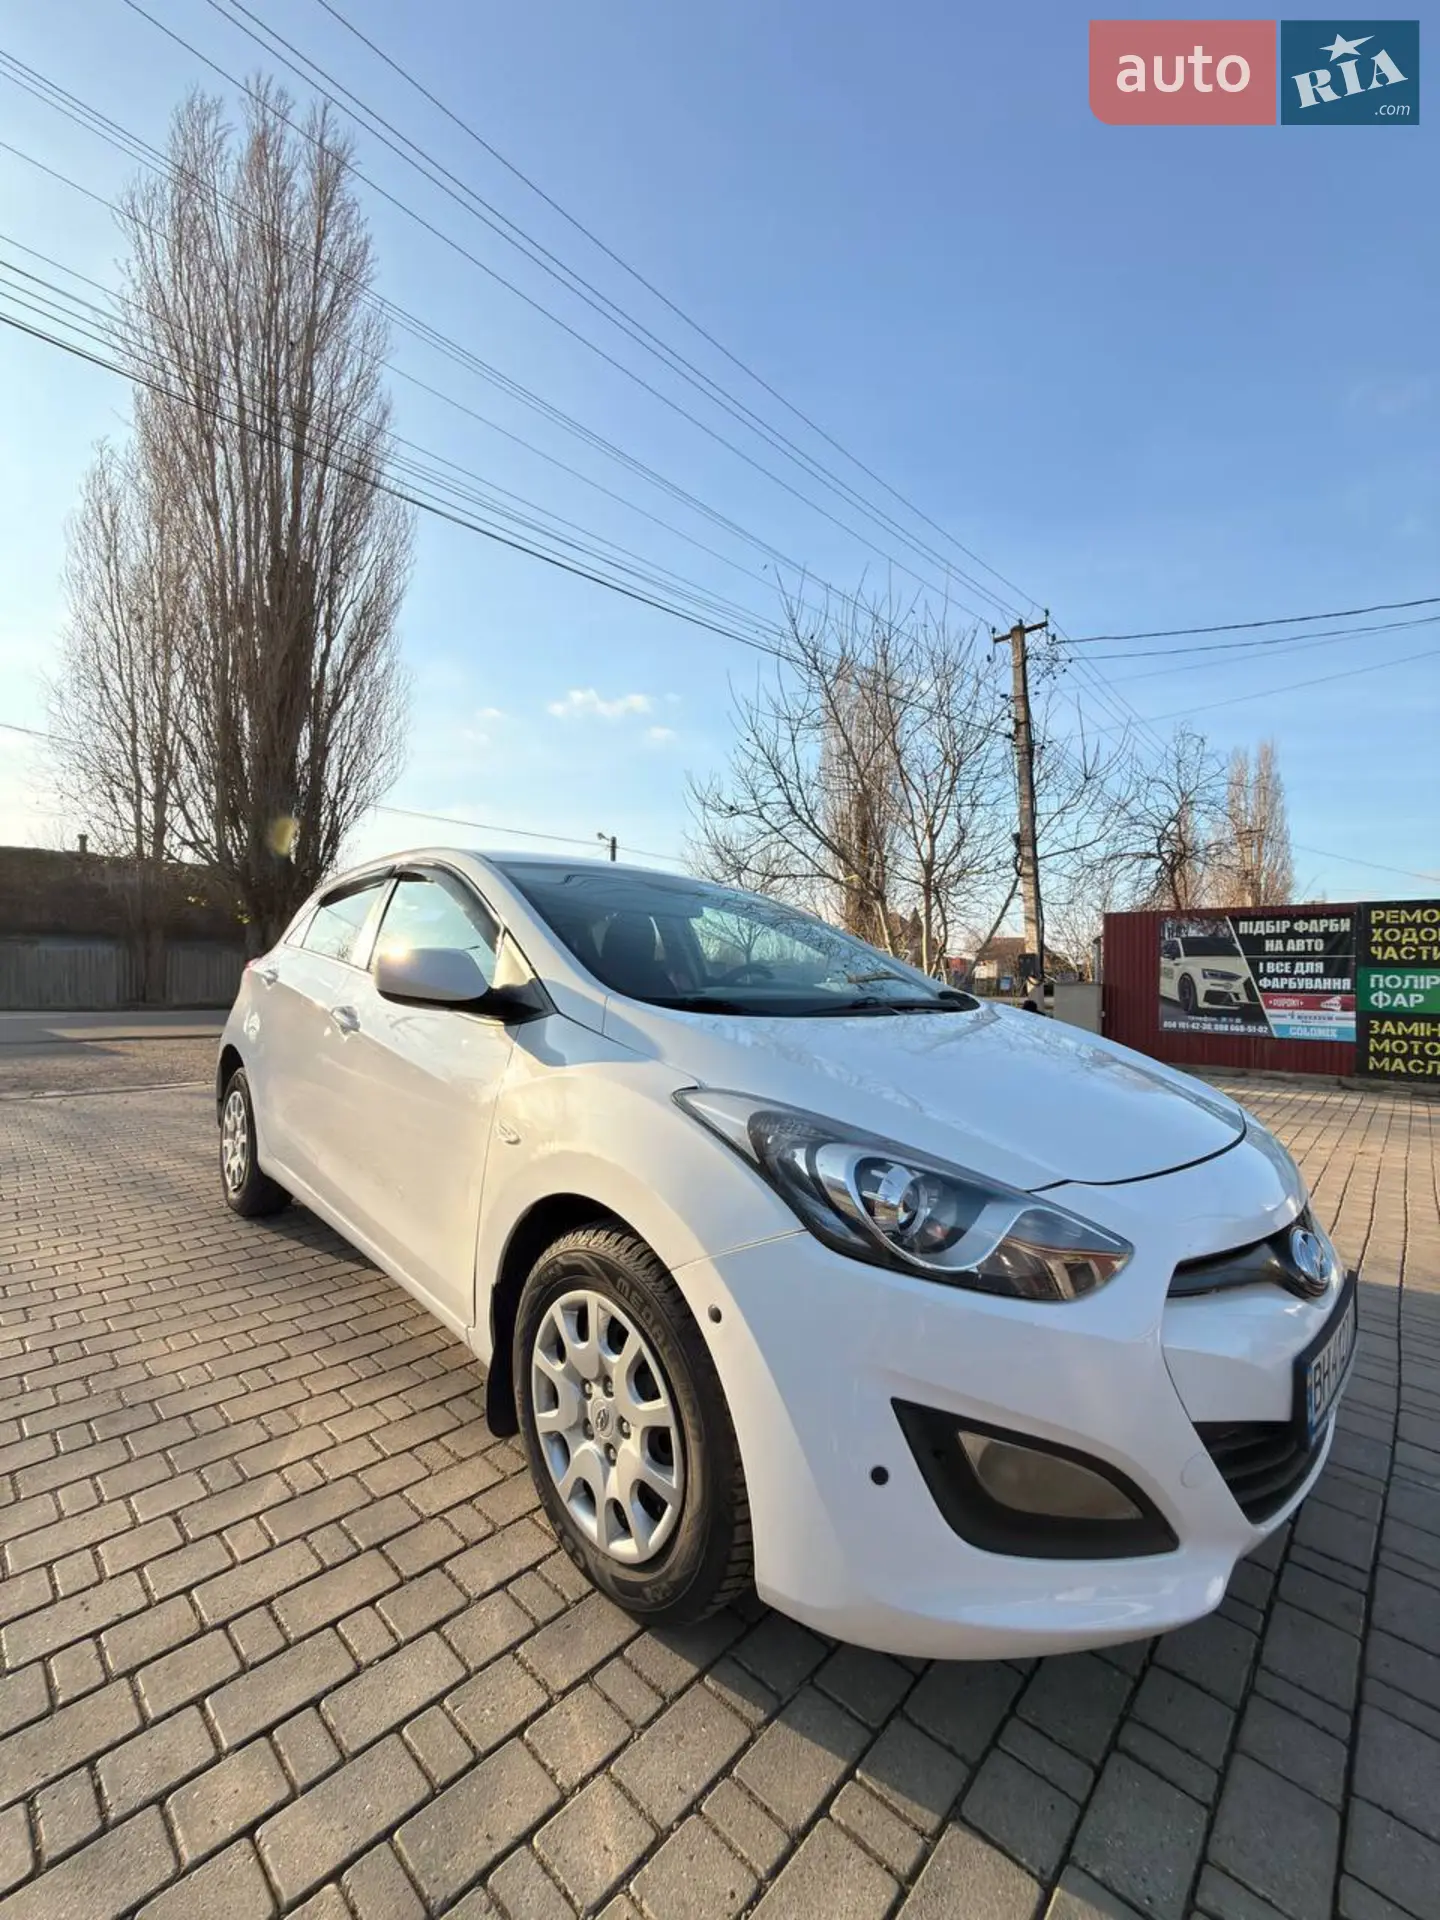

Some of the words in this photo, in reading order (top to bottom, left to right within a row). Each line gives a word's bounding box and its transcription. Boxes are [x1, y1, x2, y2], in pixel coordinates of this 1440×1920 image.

[1239, 920, 1291, 936] ПІДБІР
[1293, 918, 1351, 934] ФАРБИ
[1265, 939, 1284, 952] НА
[1286, 939, 1324, 952] АВТО
[1266, 961, 1292, 973] ВСЕ
[1294, 962, 1324, 975] ДЛЯ
[1259, 977, 1351, 990] ФАРБУВАННЯ
[1370, 991, 1425, 1009] ФАР
